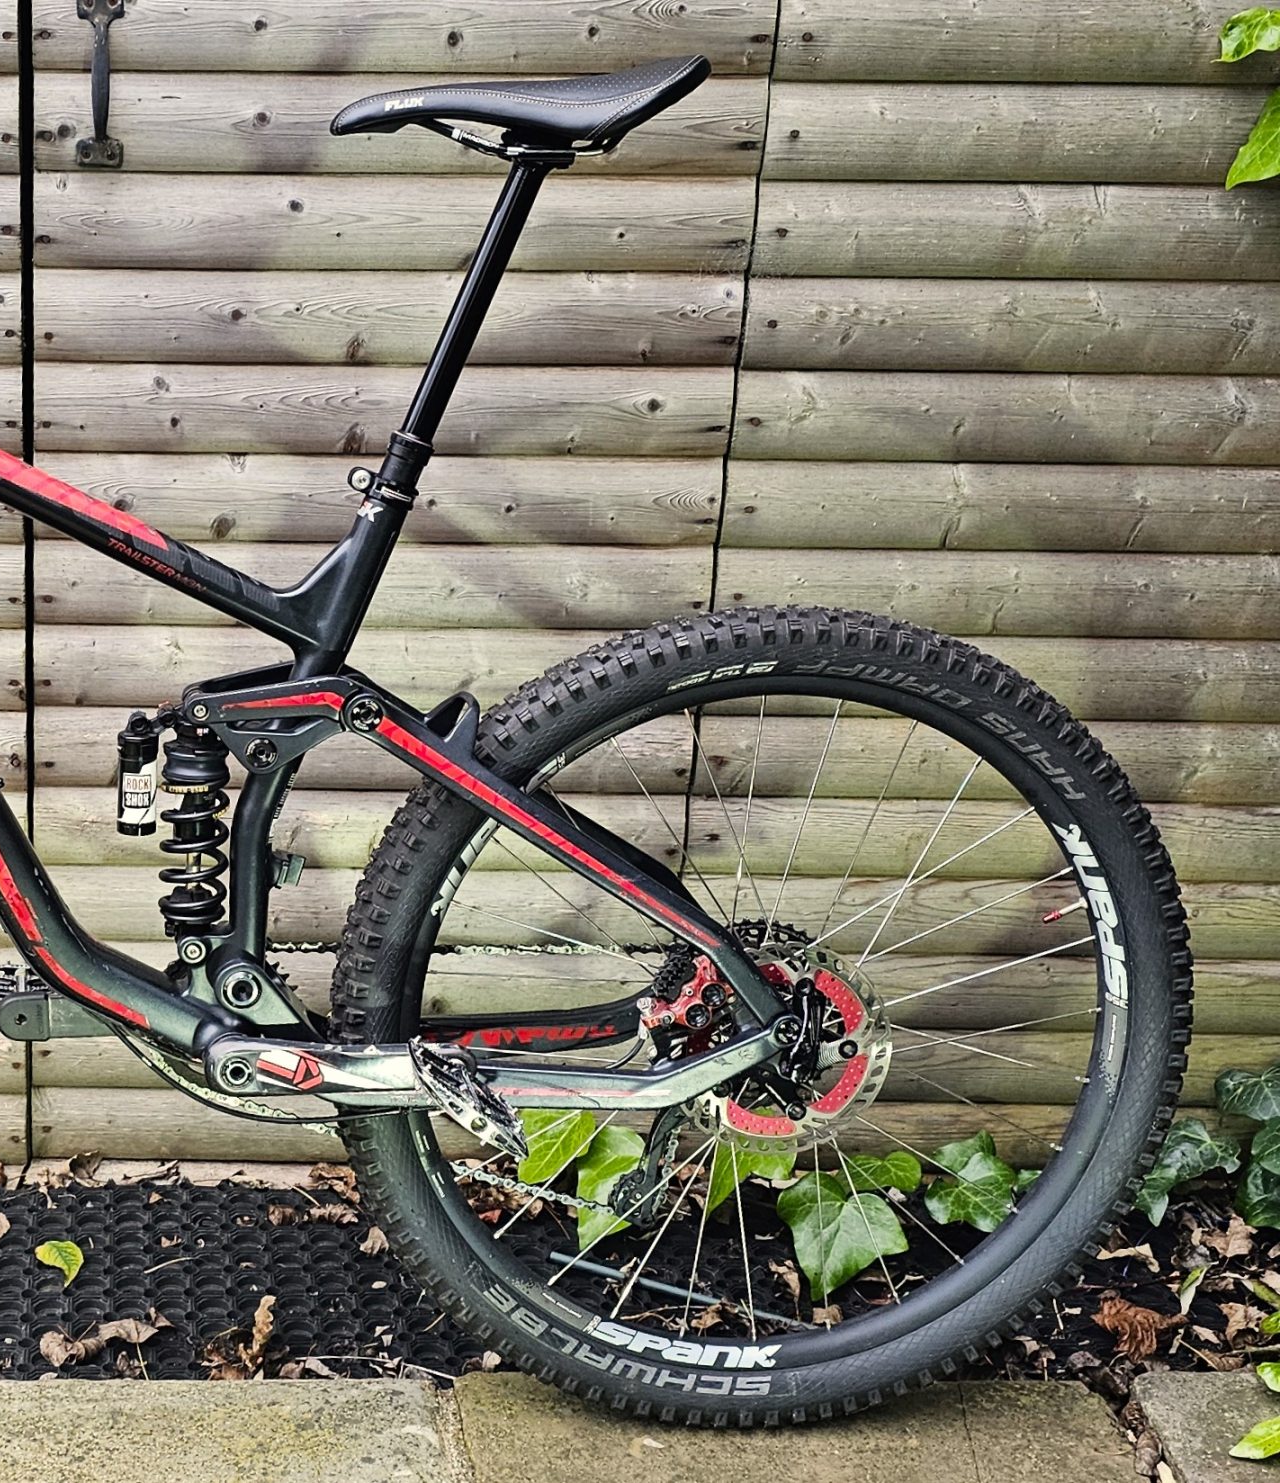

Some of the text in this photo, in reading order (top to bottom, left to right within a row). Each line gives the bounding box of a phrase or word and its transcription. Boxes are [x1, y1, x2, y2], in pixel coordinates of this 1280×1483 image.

[106, 537, 175, 578] TRAILSTER
[125, 778, 150, 790] ROCK
[124, 793, 150, 807] SHOX
[484, 1284, 771, 1396] SCHWALBE
